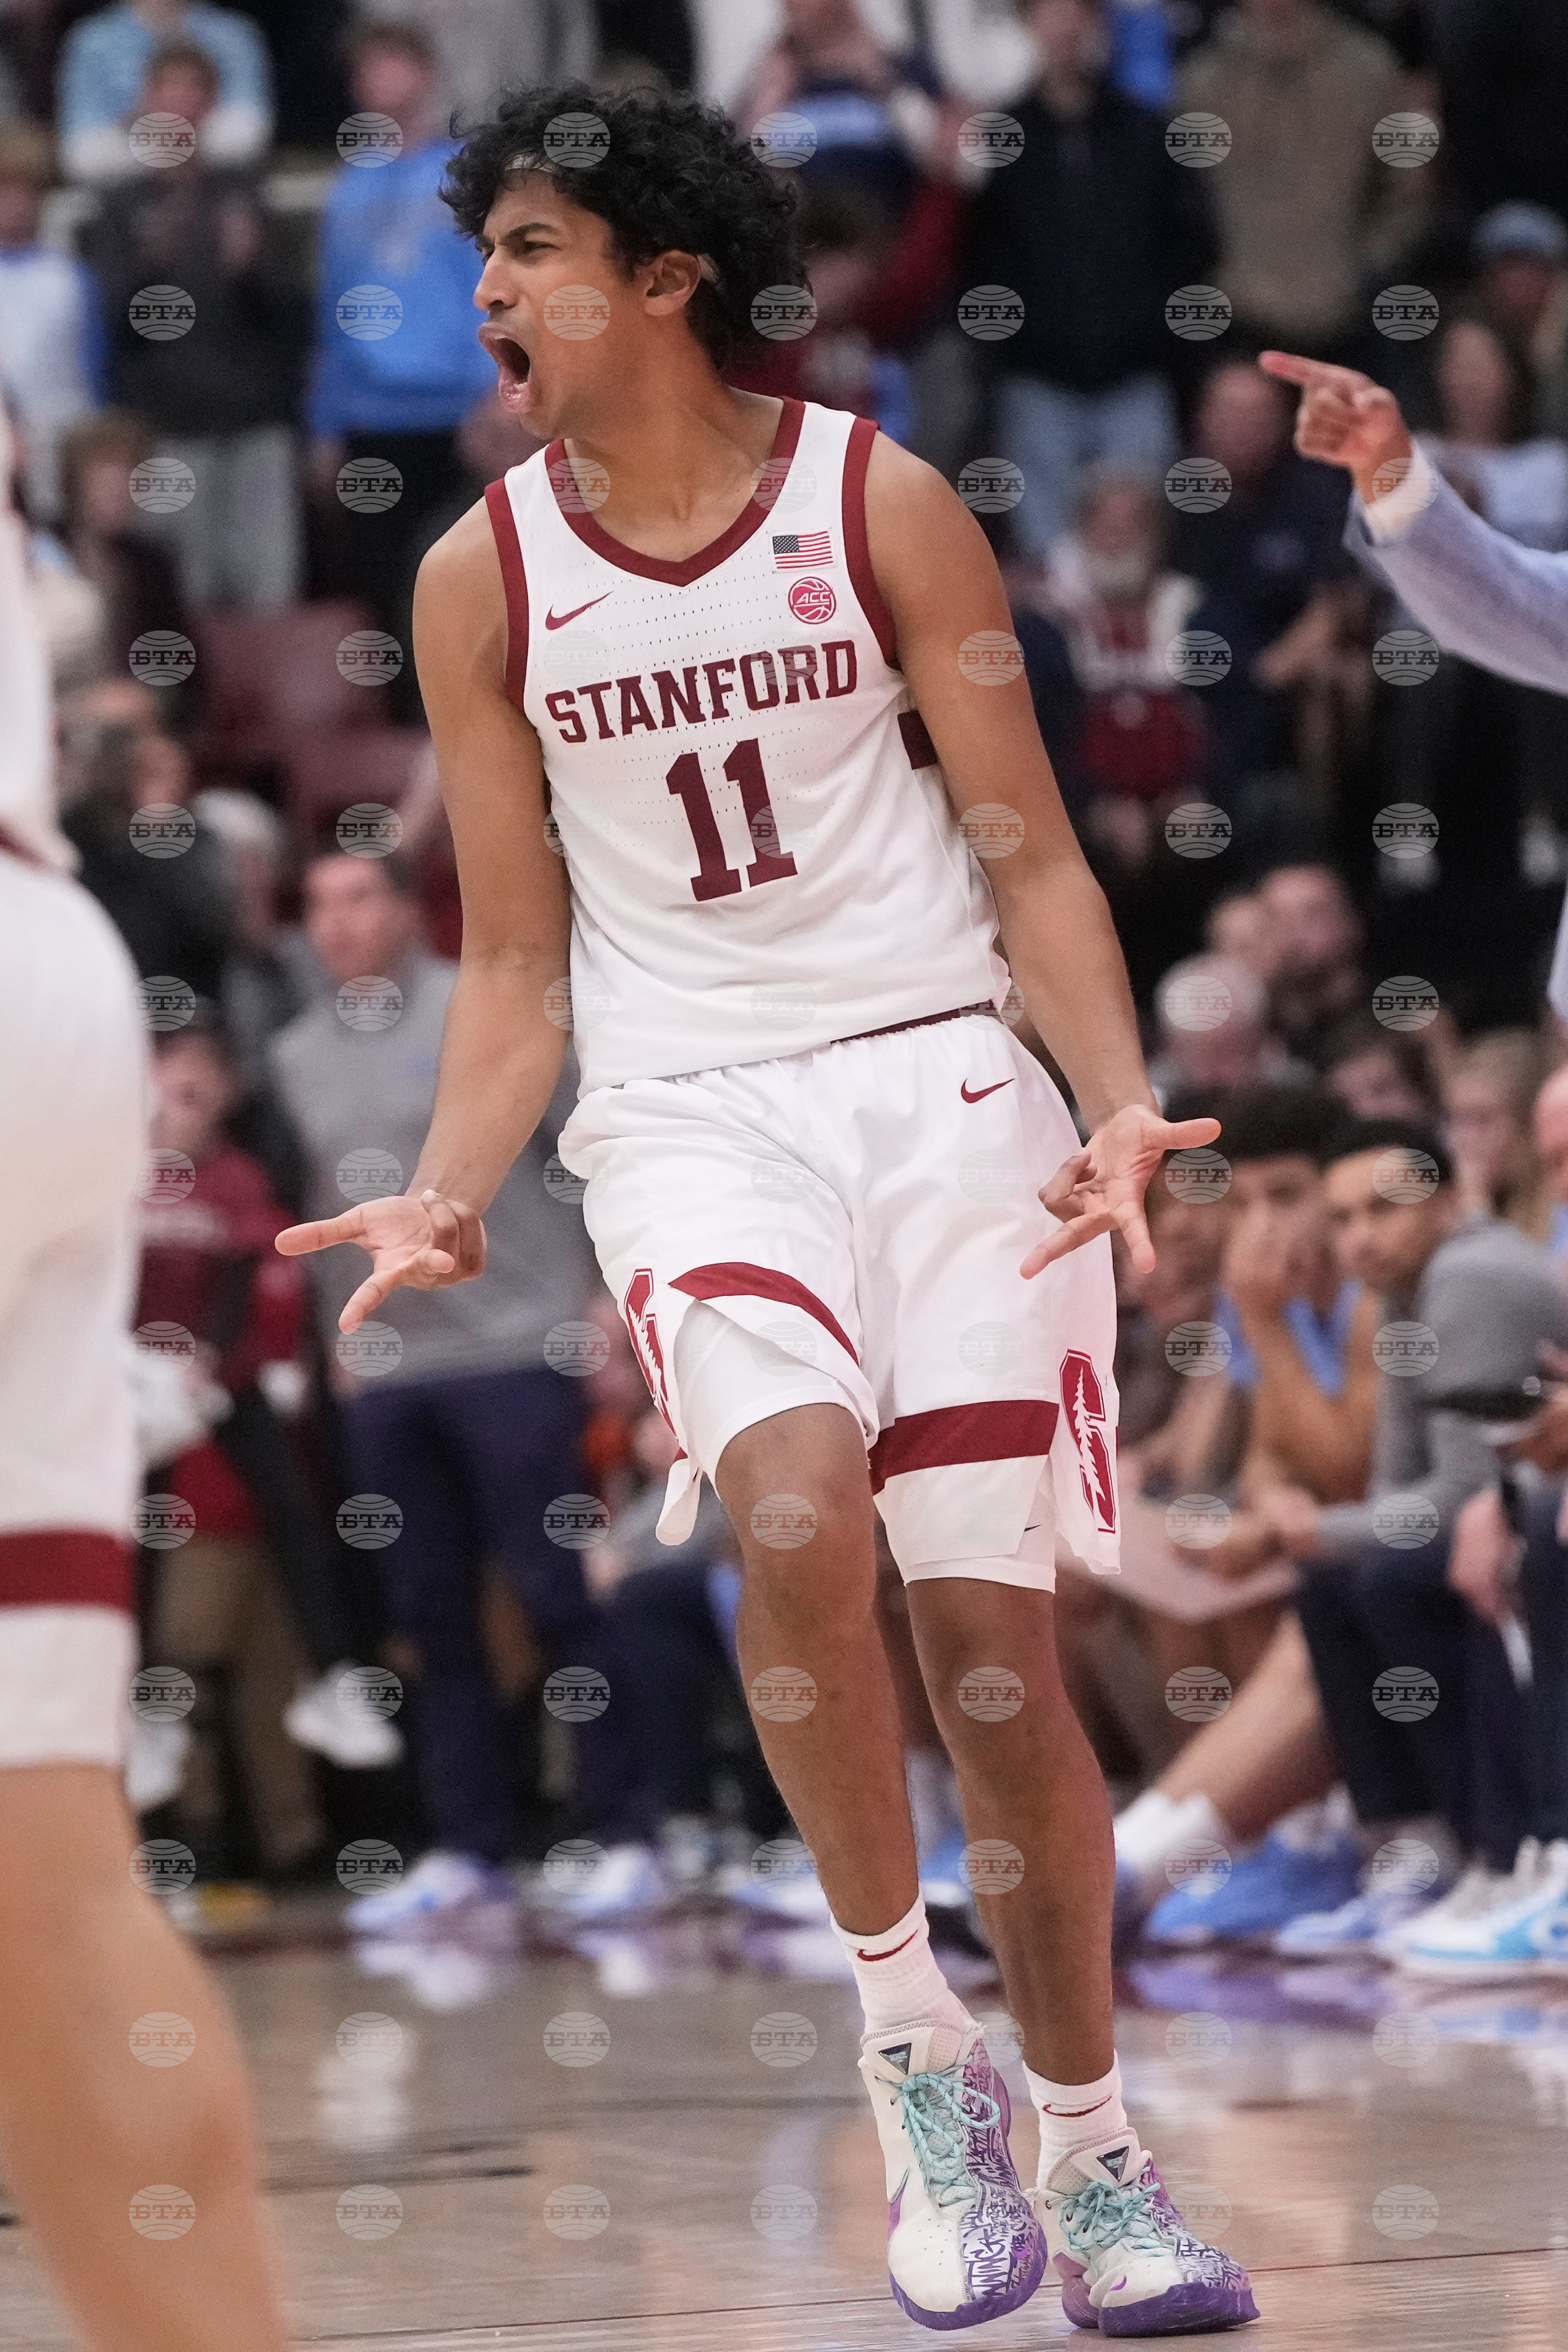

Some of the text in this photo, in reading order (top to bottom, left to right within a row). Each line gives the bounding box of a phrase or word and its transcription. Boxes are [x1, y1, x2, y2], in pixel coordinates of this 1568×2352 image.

[796, 591, 831, 604] ACC
[545, 640, 858, 743] STANFORD
[665, 737, 798, 902] 11
